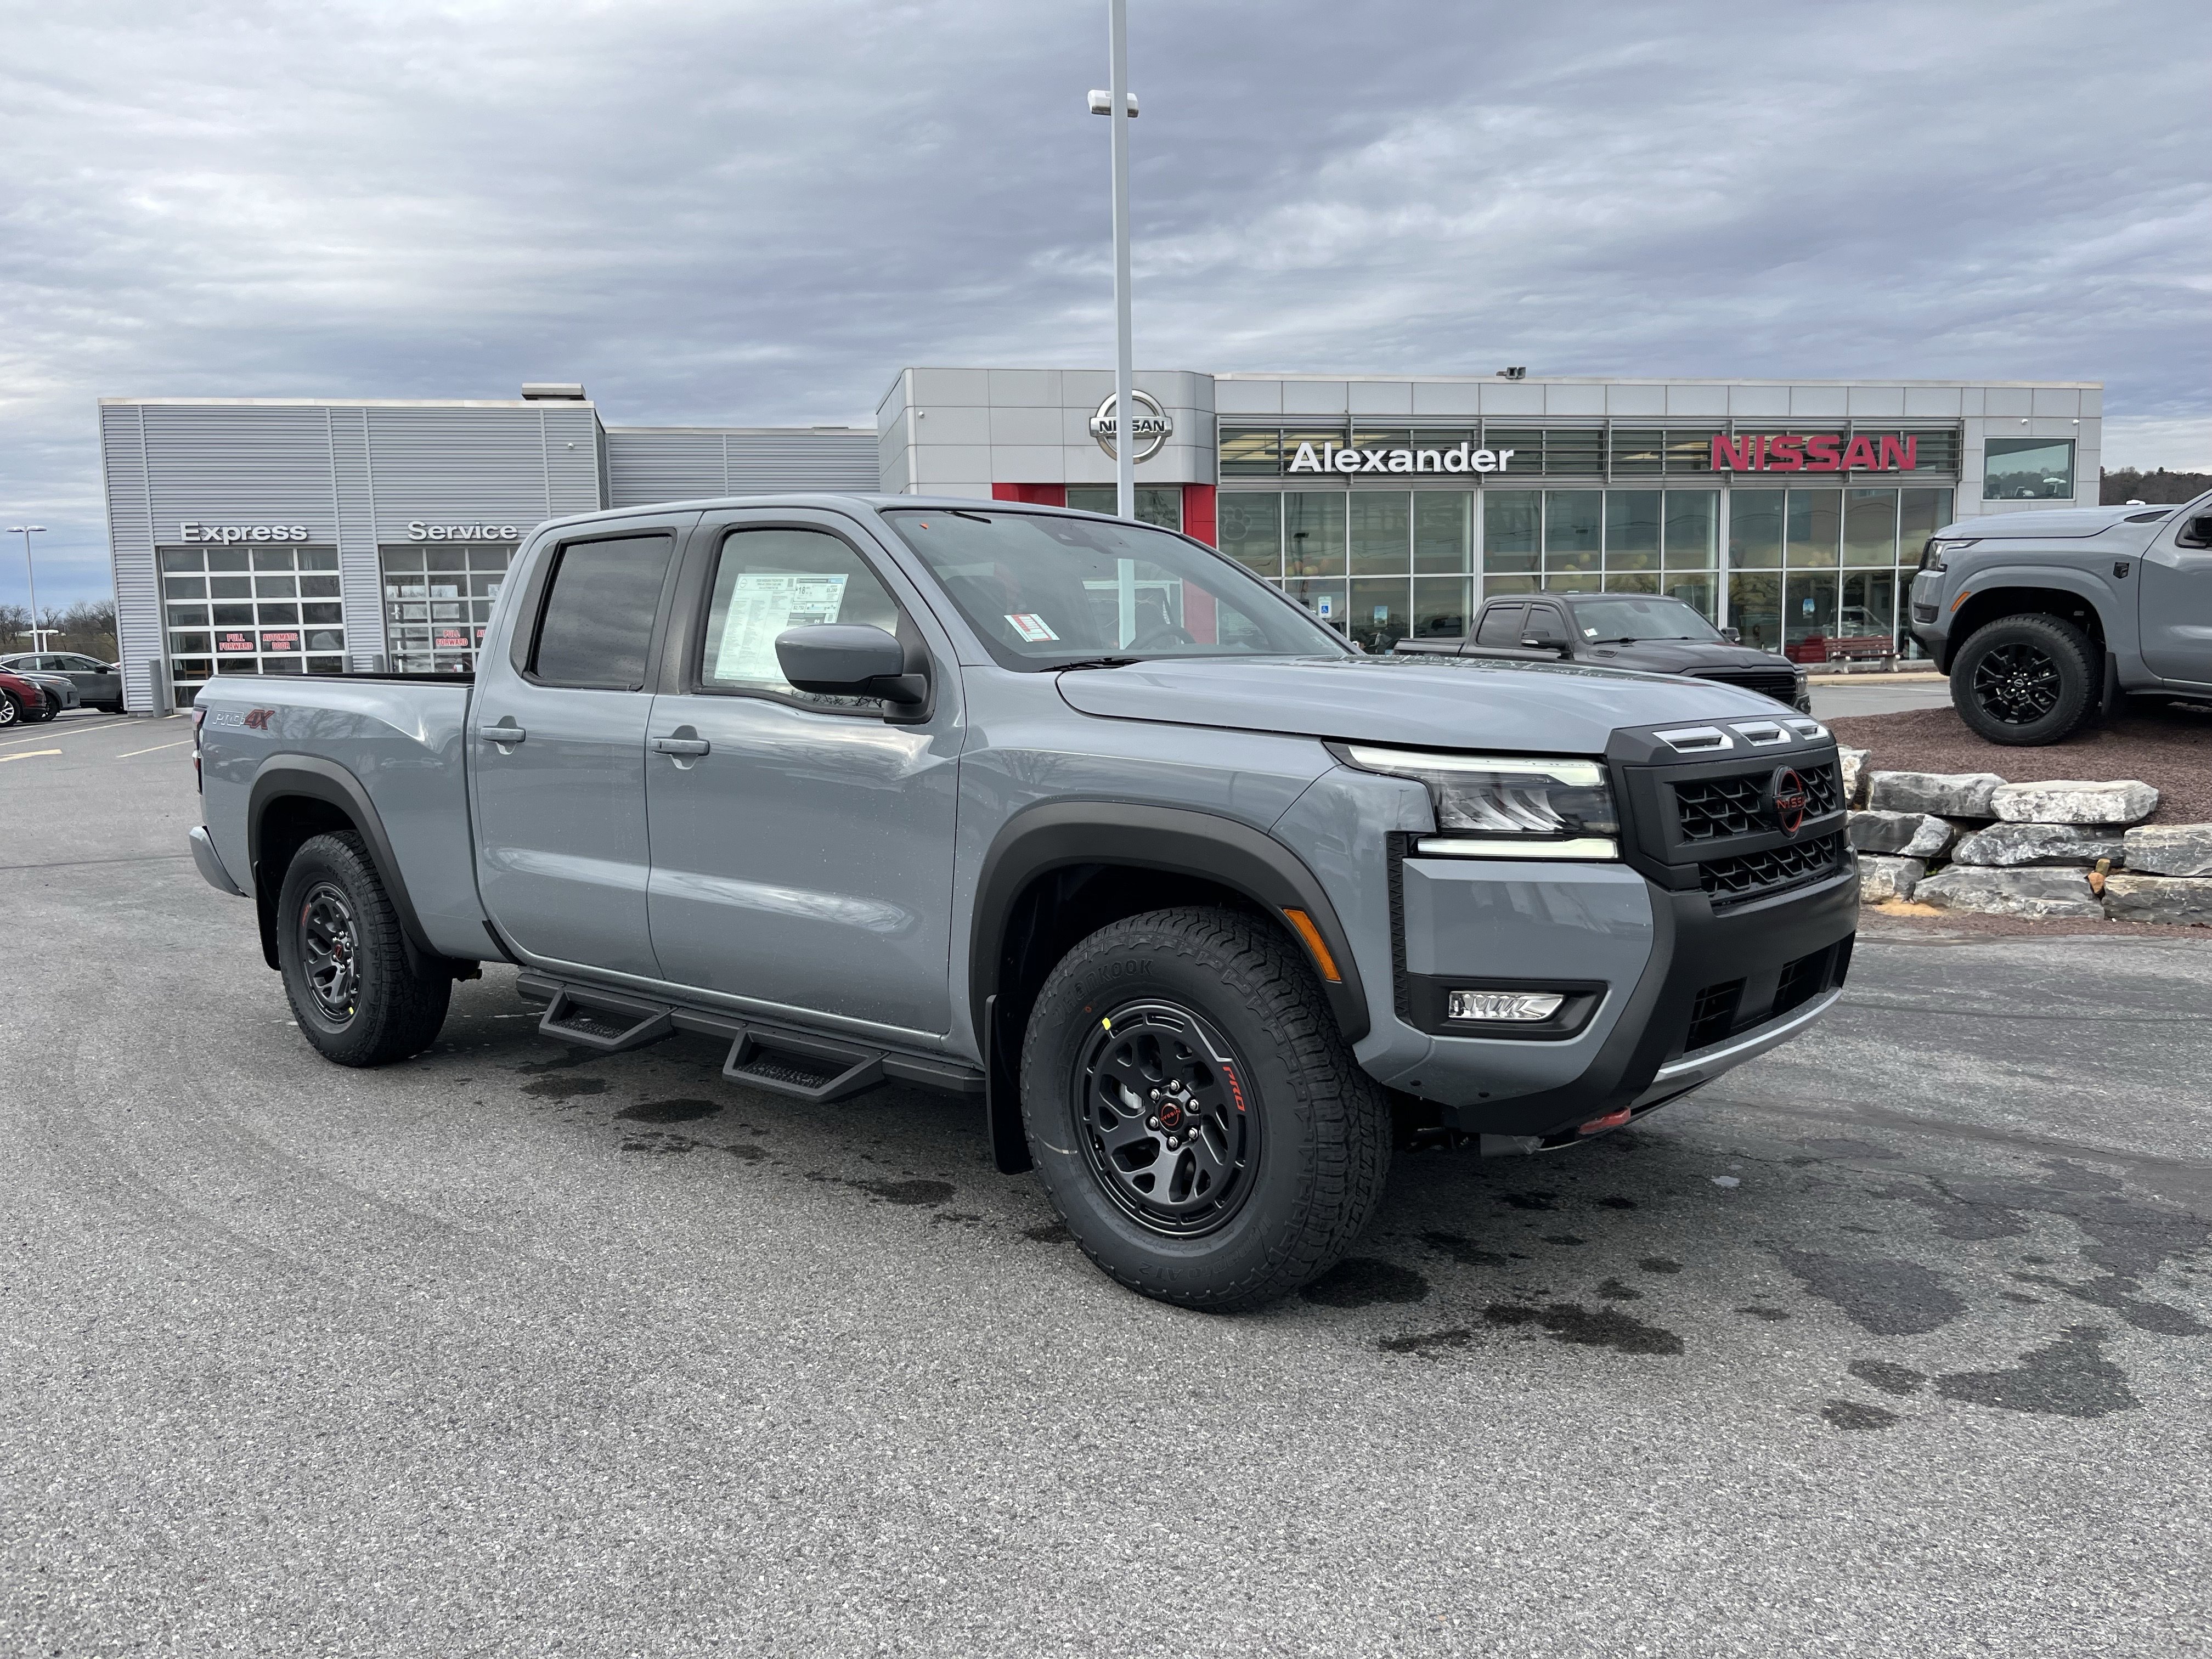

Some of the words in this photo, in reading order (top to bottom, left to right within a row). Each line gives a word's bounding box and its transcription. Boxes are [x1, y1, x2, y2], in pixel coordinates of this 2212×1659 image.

[1099, 420, 1165, 432] NISAN
[1288, 442, 1514, 473] Alexander
[1711, 435, 1917, 471] NISSAN
[180, 522, 308, 545] Express
[408, 521, 518, 540] Service
[798, 586, 806, 594] 18
[226, 633, 245, 642] PULL
[262, 633, 298, 641] AUTOMATIC
[443, 629, 460, 638] PULL
[219, 642, 253, 651] FORWARD
[272, 641, 291, 650] DOOR
[436, 638, 469, 646] FORWARD
[1222, 1066, 1245, 1111] PRO
